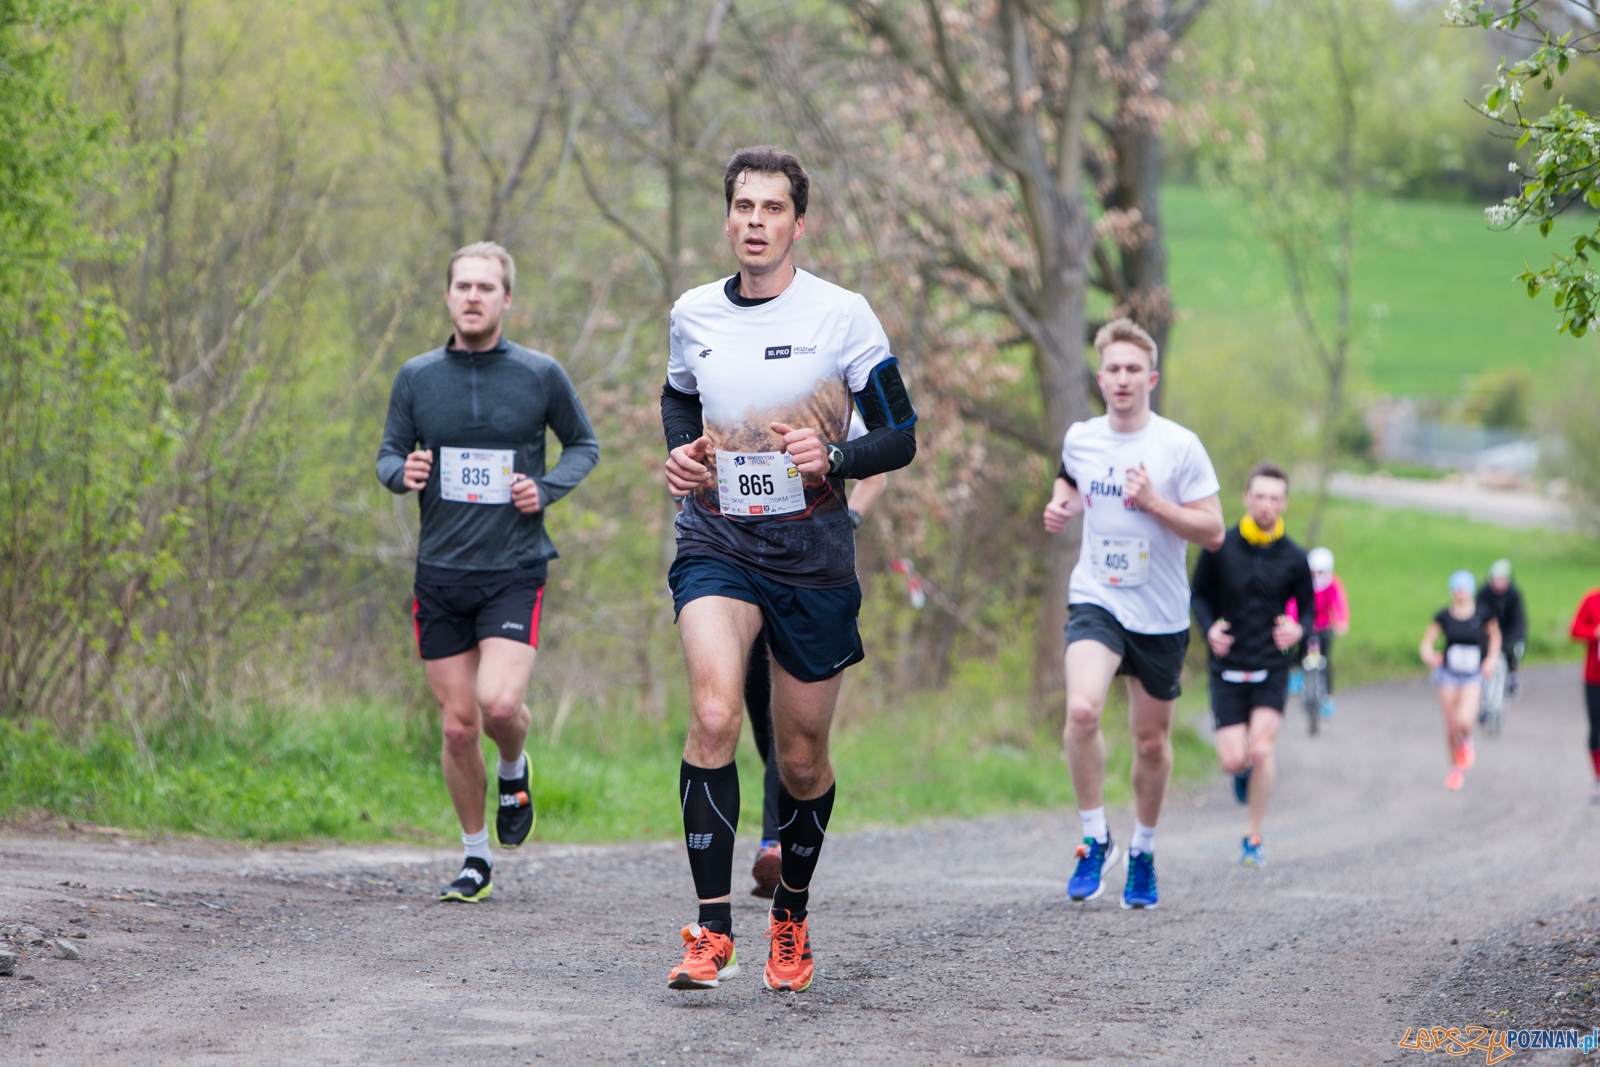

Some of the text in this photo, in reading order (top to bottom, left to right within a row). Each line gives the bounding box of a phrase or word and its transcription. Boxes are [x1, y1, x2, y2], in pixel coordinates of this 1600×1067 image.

[699, 349, 712, 358] 4F
[775, 348, 790, 356] PKO
[462, 467, 490, 486] 835
[738, 474, 774, 496] 865
[1090, 481, 1122, 497] RUN
[1105, 553, 1130, 570] 405
